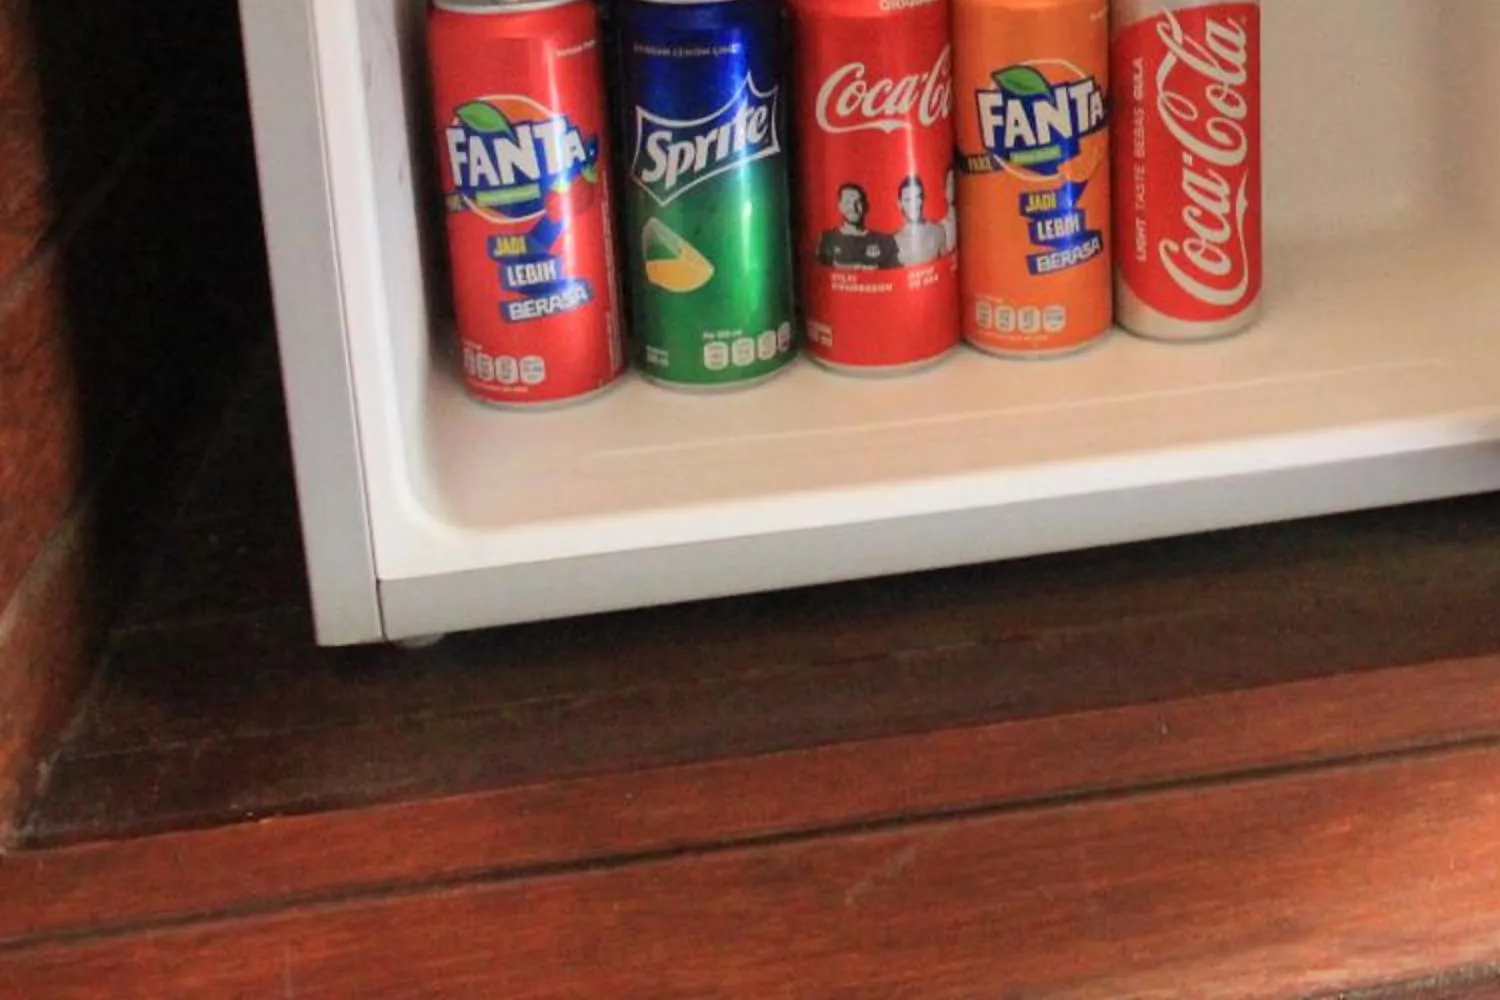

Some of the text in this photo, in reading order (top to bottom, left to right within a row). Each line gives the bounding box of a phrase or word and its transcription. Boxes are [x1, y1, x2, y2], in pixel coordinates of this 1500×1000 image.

[977, 80, 1104, 149] FANTA
[446, 116, 587, 187] FANTA
[641, 96, 769, 190] Sprite
[1157, 8, 1248, 306] Coca-Cola
[1026, 192, 1057, 213] JADI
[1134, 163, 1146, 210] TASTE
[507, 260, 557, 287] LEBIH
[1036, 235, 1100, 273] BERASA
[508, 281, 590, 321] BERASA
